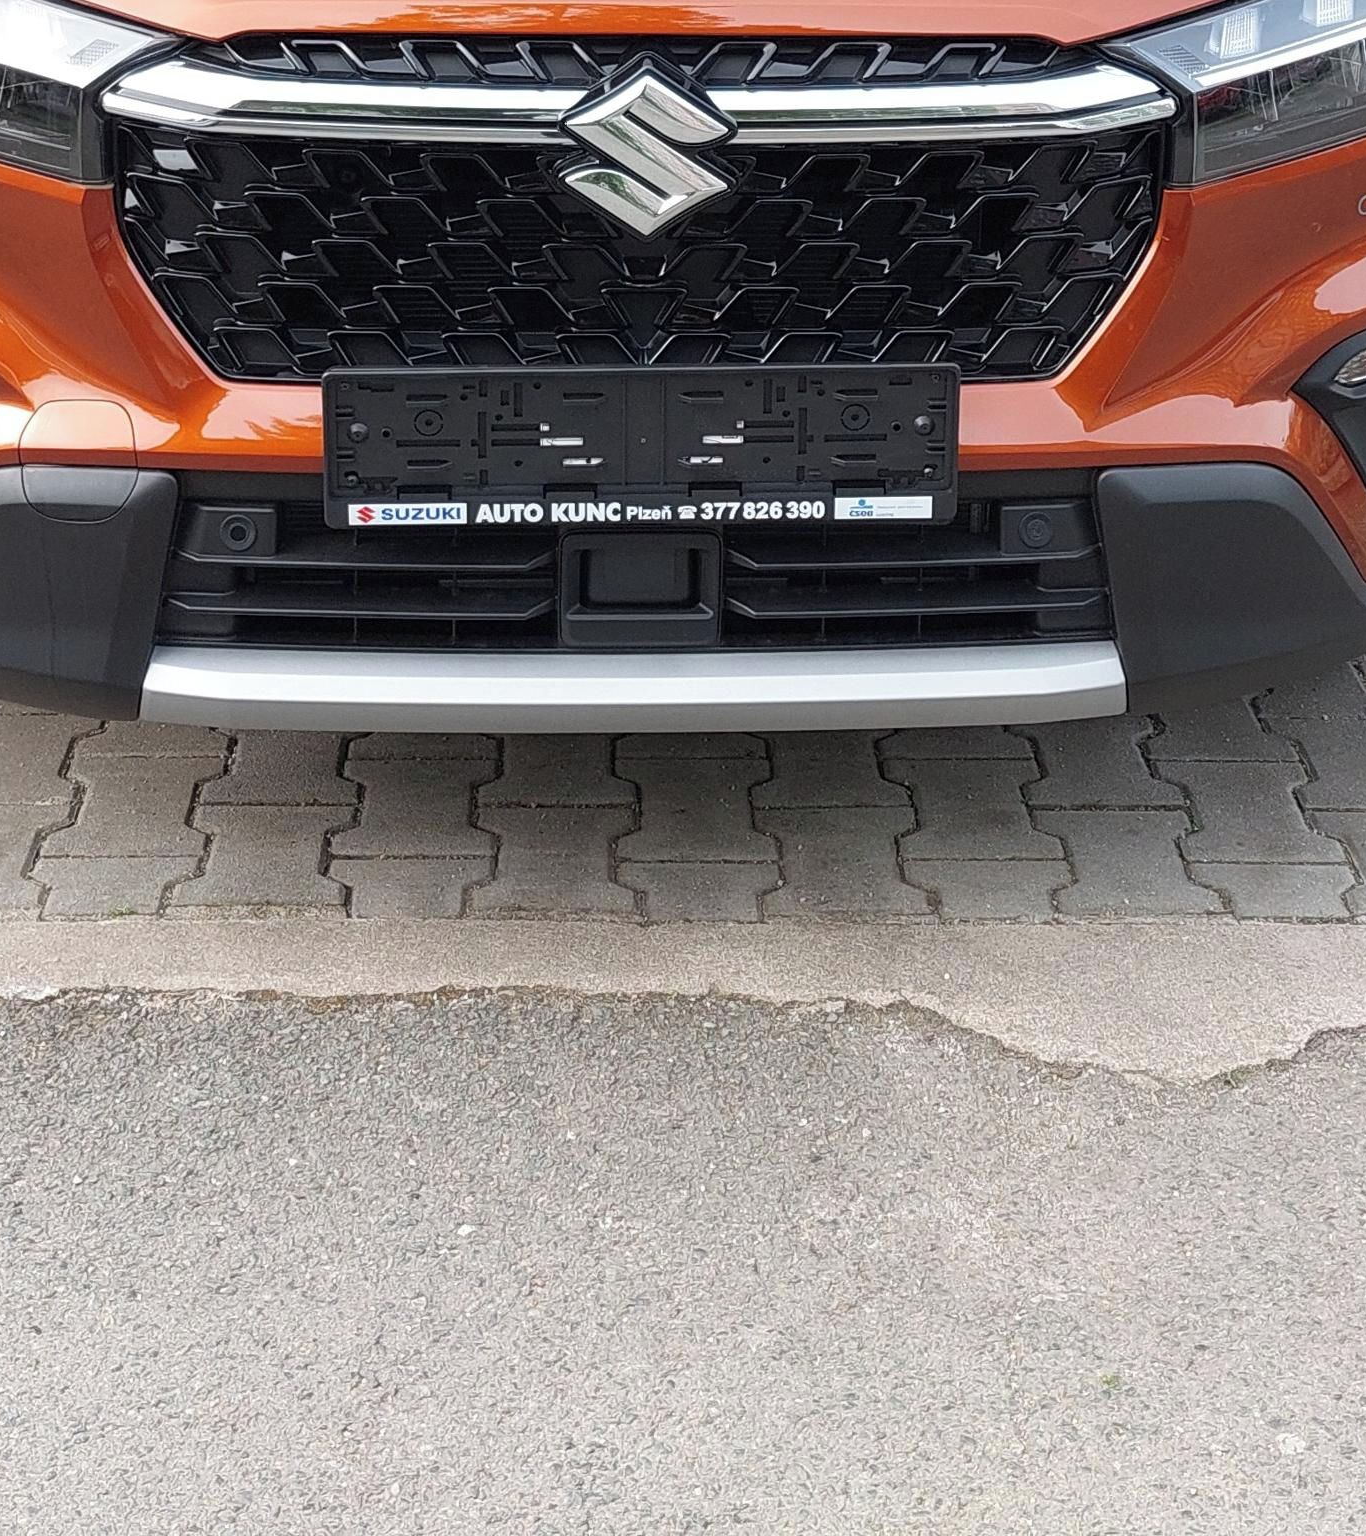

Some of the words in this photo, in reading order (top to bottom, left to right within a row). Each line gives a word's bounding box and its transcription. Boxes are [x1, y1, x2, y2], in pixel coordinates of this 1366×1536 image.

[381, 507, 461, 521] SUZUKI
[475, 503, 544, 524] AUTO
[551, 502, 622, 523] KUNC
[626, 504, 672, 521] Plzeň
[700, 502, 741, 520] 377
[742, 501, 786, 520] 826
[785, 500, 825, 519] 390
